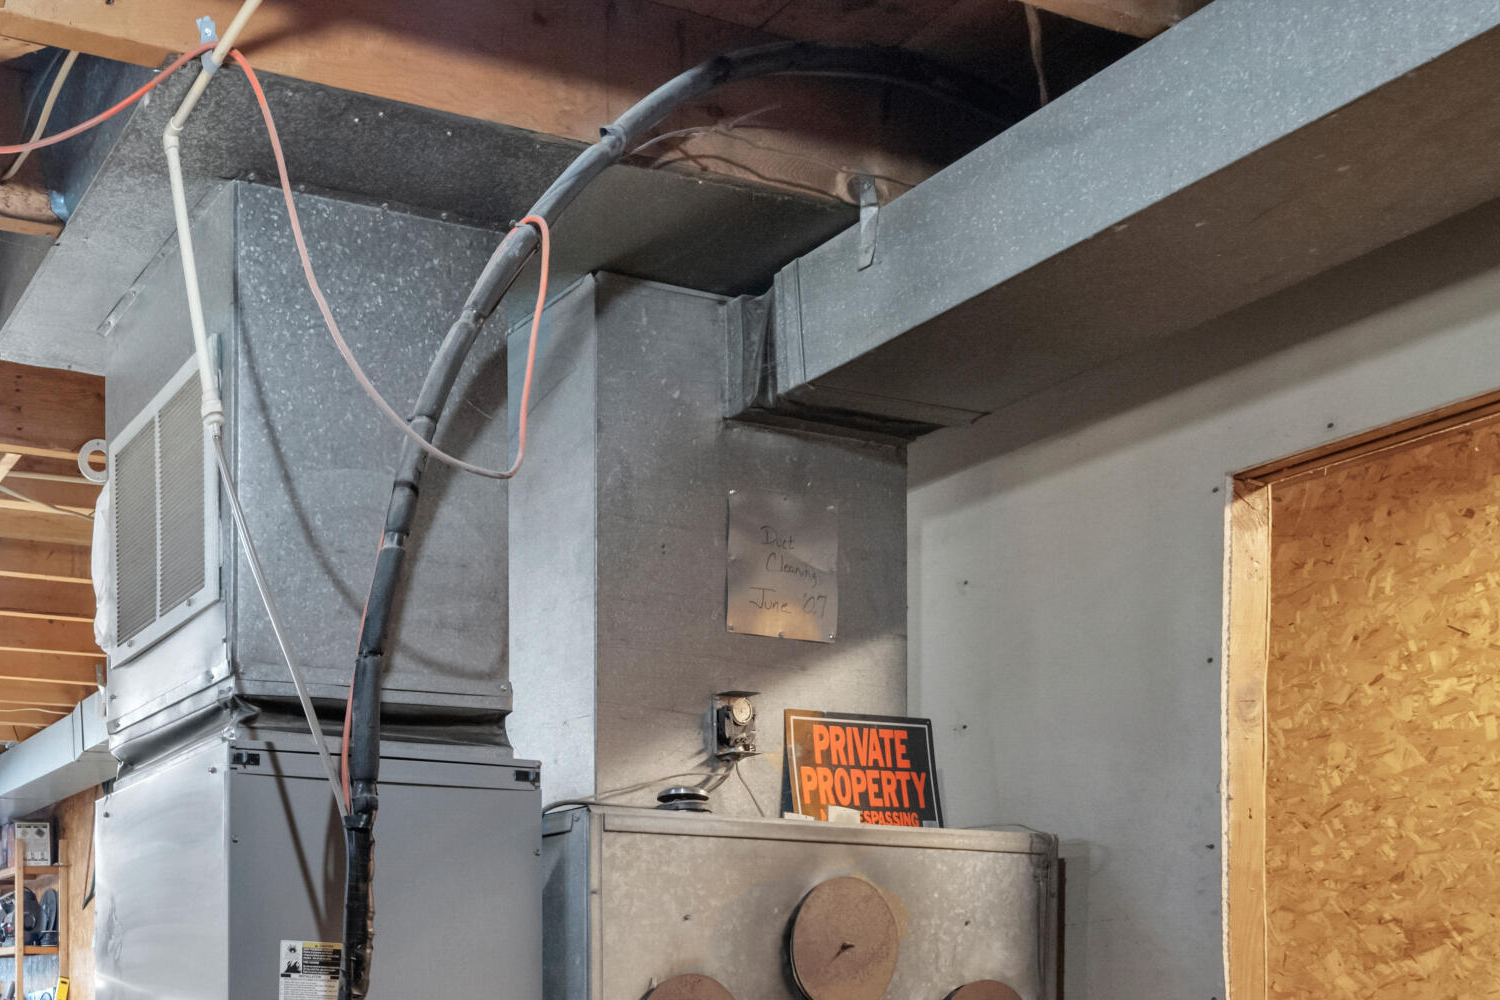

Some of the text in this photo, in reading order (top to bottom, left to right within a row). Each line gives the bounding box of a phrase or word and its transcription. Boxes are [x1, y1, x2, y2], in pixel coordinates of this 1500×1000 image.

[760, 525, 795, 550] Duct
[765, 552, 817, 588] Cleaning
[748, 586, 792, 614] June
[813, 725, 911, 769] PRIVATE
[800, 766, 927, 809] PROPERTY
